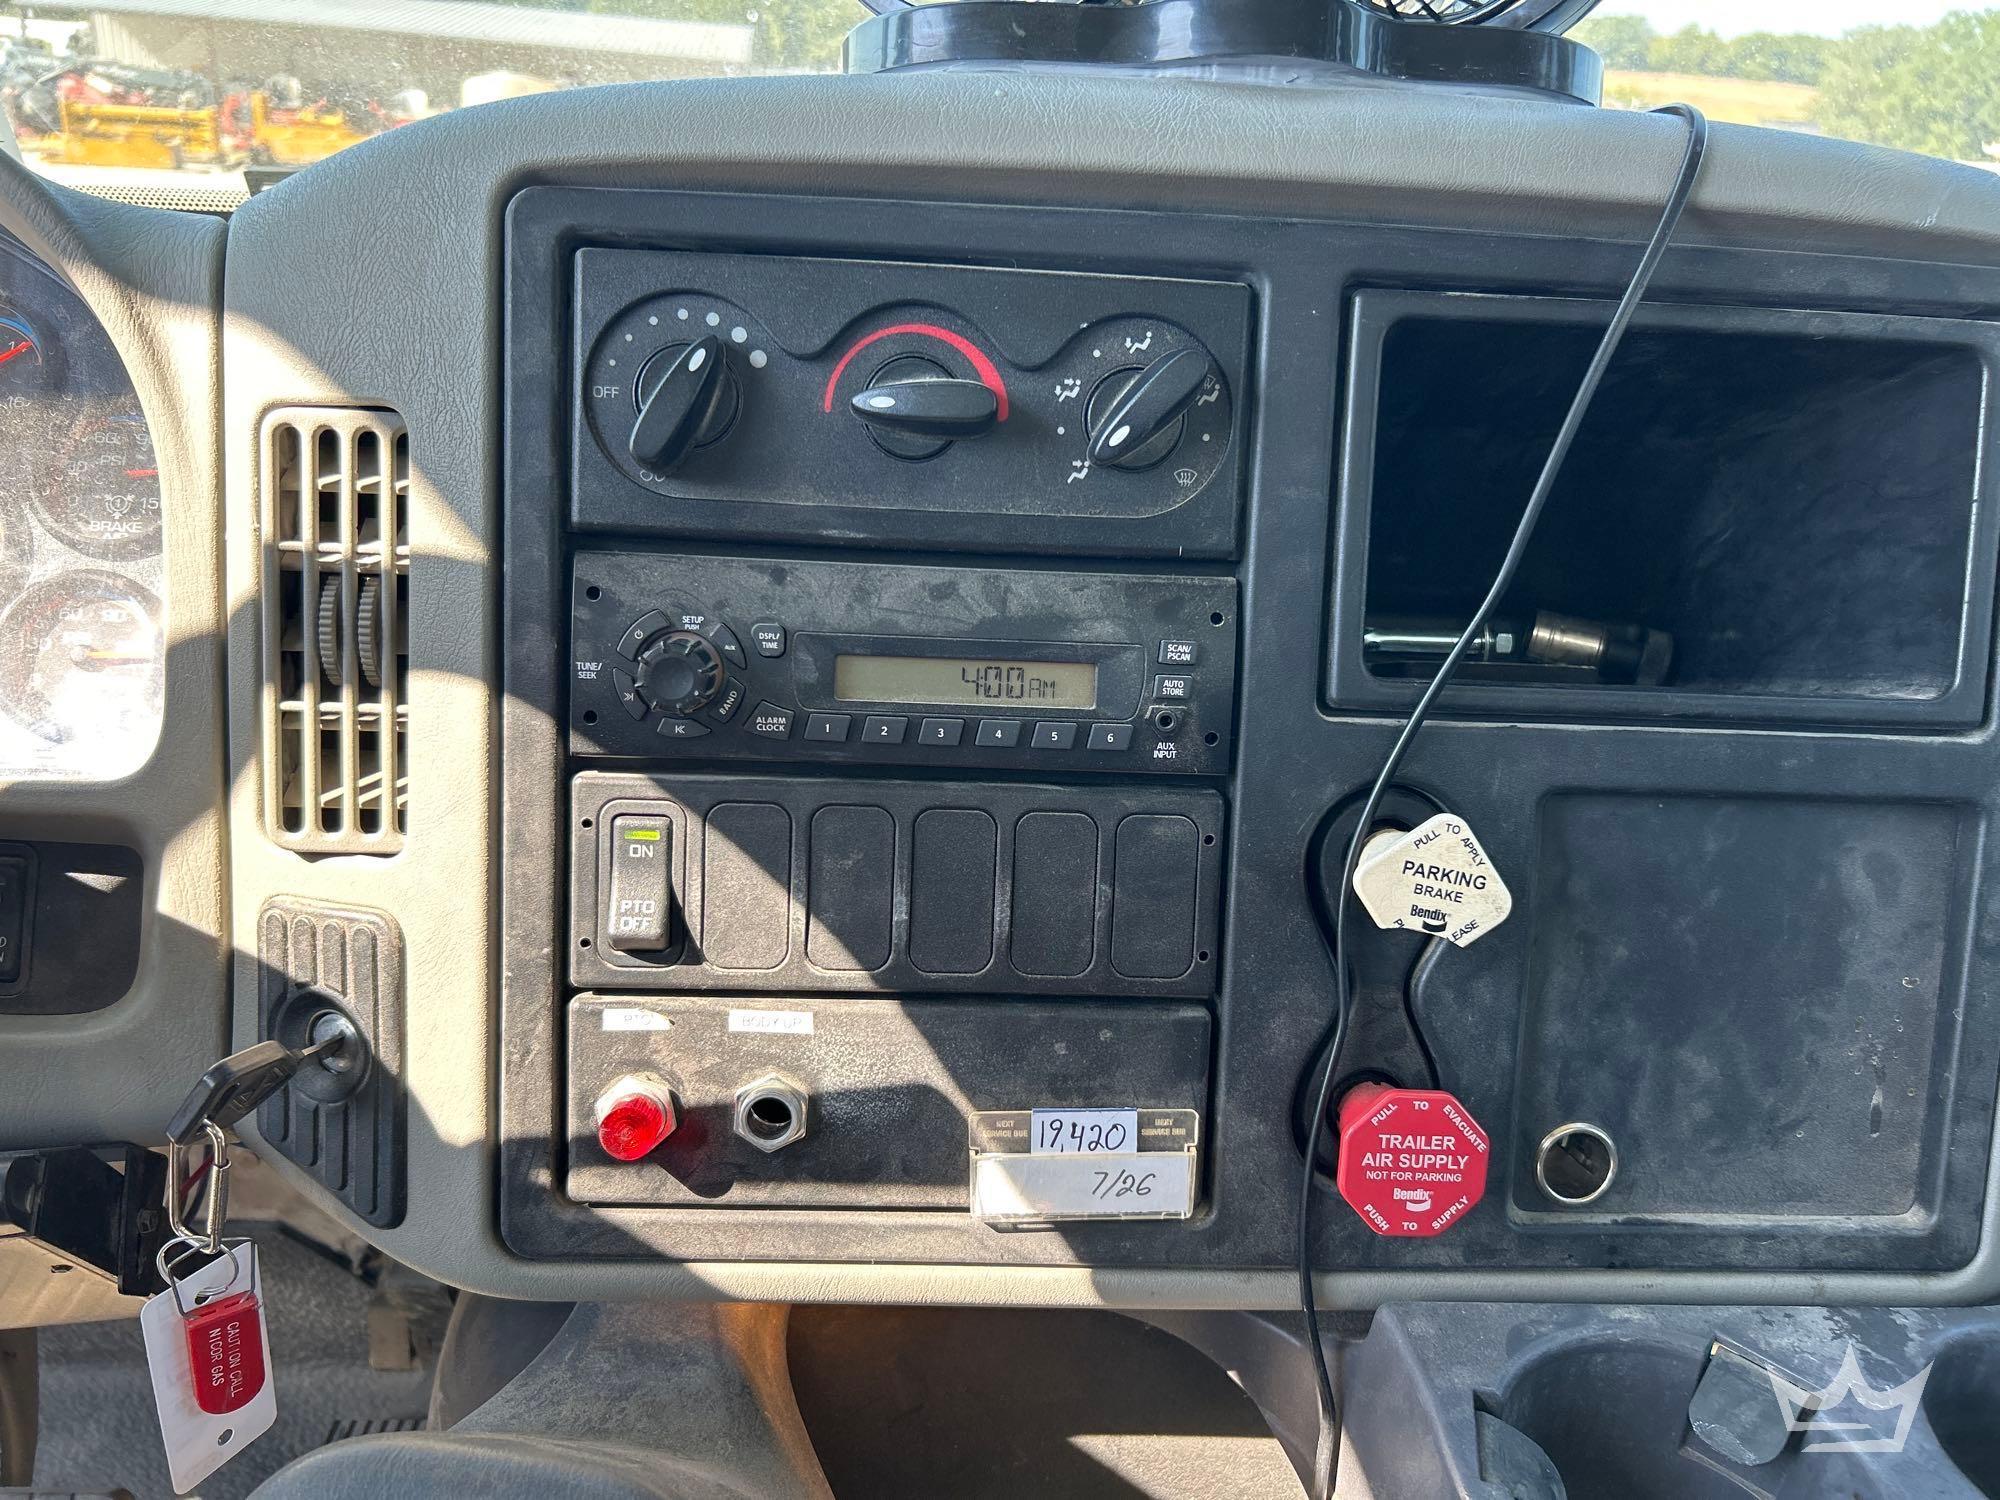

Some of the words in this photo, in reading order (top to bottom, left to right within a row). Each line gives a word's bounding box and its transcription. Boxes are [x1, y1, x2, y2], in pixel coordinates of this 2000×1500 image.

[593, 386, 619, 398] OFF
[90, 520, 142, 532] BRAKE
[682, 616, 704, 624] SETUP
[1167, 644, 1192, 653] SCAN/
[1167, 652, 1191, 661] PSCAN
[576, 662, 602, 671] TUNE/
[1163, 680, 1184, 688] AUTO
[1162, 688, 1184, 696] STORE
[719, 690, 738, 715] BAND
[756, 716, 787, 724] ALARM
[756, 724, 785, 732] CLOCK
[824, 724, 830, 734] 1
[880, 726, 888, 736] 2
[937, 728, 944, 738] 3
[995, 729, 1002, 739] 4
[1051, 731, 1058, 741] 5
[1107, 733, 1114, 743] 6
[1157, 742, 1175, 750] AUX
[1153, 750, 1177, 759] INPUT
[629, 844, 654, 858] ON
[1413, 829, 1441, 849] PULL
[1445, 823, 1461, 834] TO
[1460, 837, 1486, 867] APPLY
[1402, 860, 1487, 890] PARKING
[1413, 883, 1464, 903] BRAKE
[621, 900, 656, 914] PTO
[1410, 904, 1447, 922] Bendix
[620, 917, 651, 930] OFF
[1449, 919, 1480, 942] EASE
[1370, 1102, 1398, 1127] PULL
[1413, 1101, 1429, 1110] TO
[1442, 1104, 1487, 1153] EVACUATE
[1040, 1118, 1126, 1153] 19,420
[1378, 1134, 1456, 1151] TRAILER
[1361, 1152, 1393, 1168] AIR
[1398, 1153, 1469, 1170] SUPPLY
[1366, 1170, 1388, 1181] NOT
[1390, 1171, 1412, 1181] FOR
[1415, 1172, 1462, 1182] PARKING
[1092, 1168, 1156, 1200] 7/26
[1393, 1187, 1430, 1201] Bendix
[1363, 1203, 1390, 1231] PUSH
[1402, 1221, 1418, 1231] TO
[1431, 1195, 1469, 1230] SUPPLY
[209, 1327, 224, 1363] NICOR
[227, 1321, 241, 1367] CAUTION
[212, 1365, 225, 1386] GAS
[229, 1369, 243, 1398] CALL
